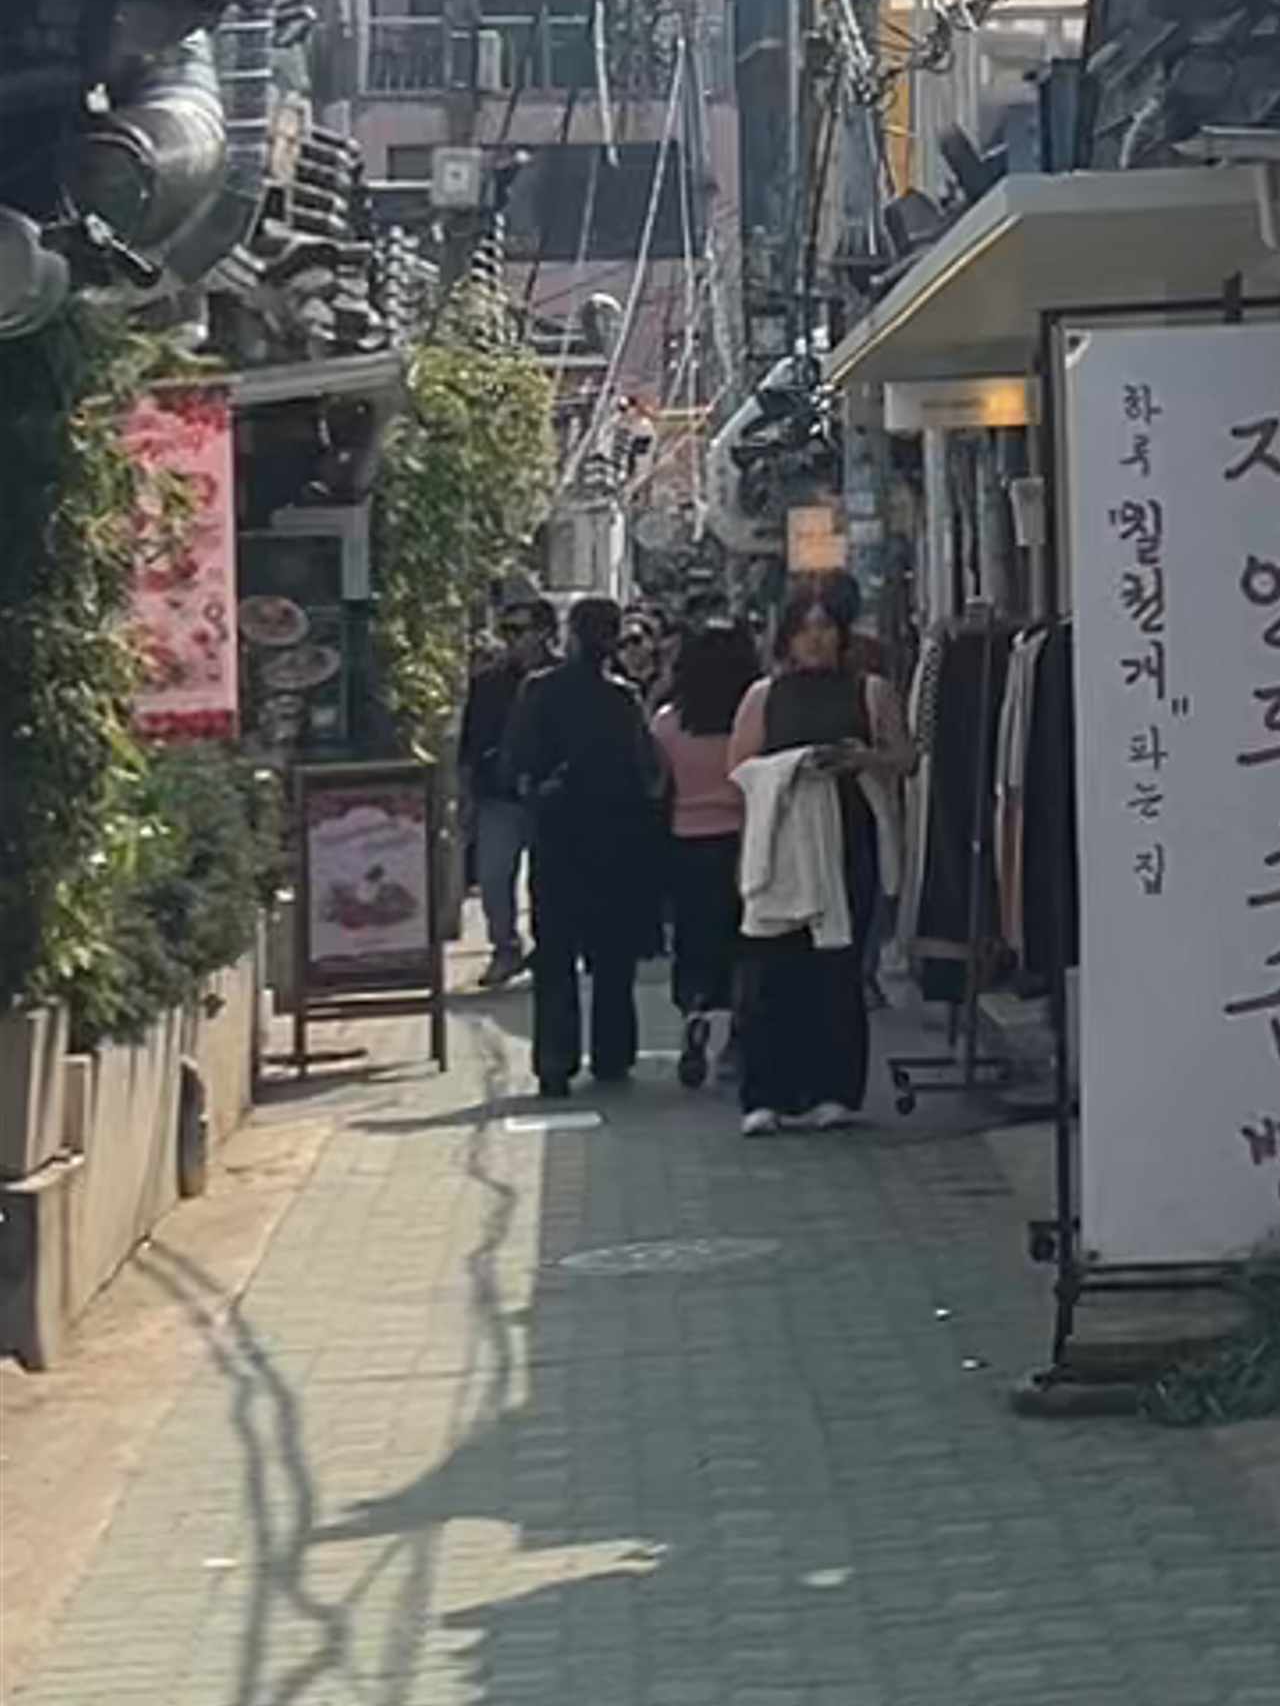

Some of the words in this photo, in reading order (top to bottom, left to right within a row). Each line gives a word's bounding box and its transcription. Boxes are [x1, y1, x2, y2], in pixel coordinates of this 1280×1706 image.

[1119, 384, 1163, 476] 하루
[1128, 725, 1168, 818] 파는
[1132, 843, 1165, 895] 집
